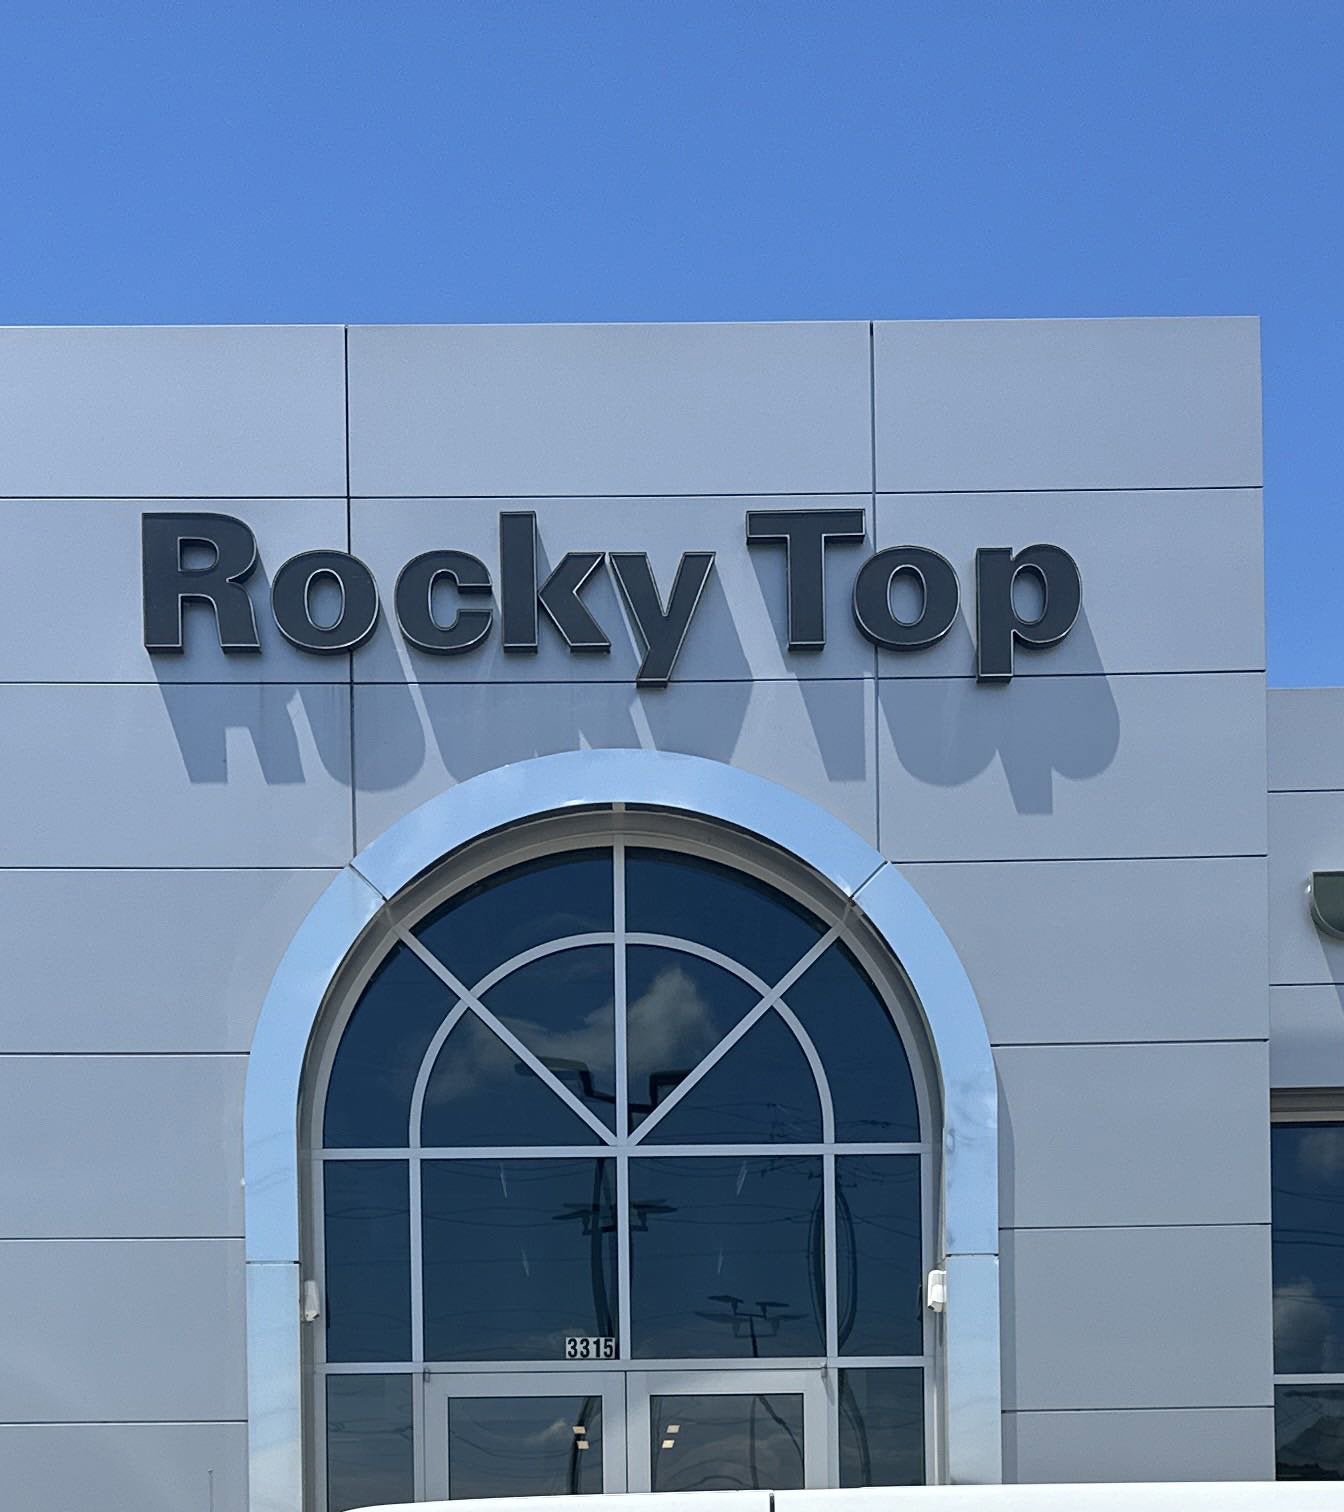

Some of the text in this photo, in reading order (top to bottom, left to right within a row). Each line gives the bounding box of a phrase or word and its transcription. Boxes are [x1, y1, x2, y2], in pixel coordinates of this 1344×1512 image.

[141, 507, 1084, 688] Rocky Top
[567, 1338, 614, 1358] 3315
